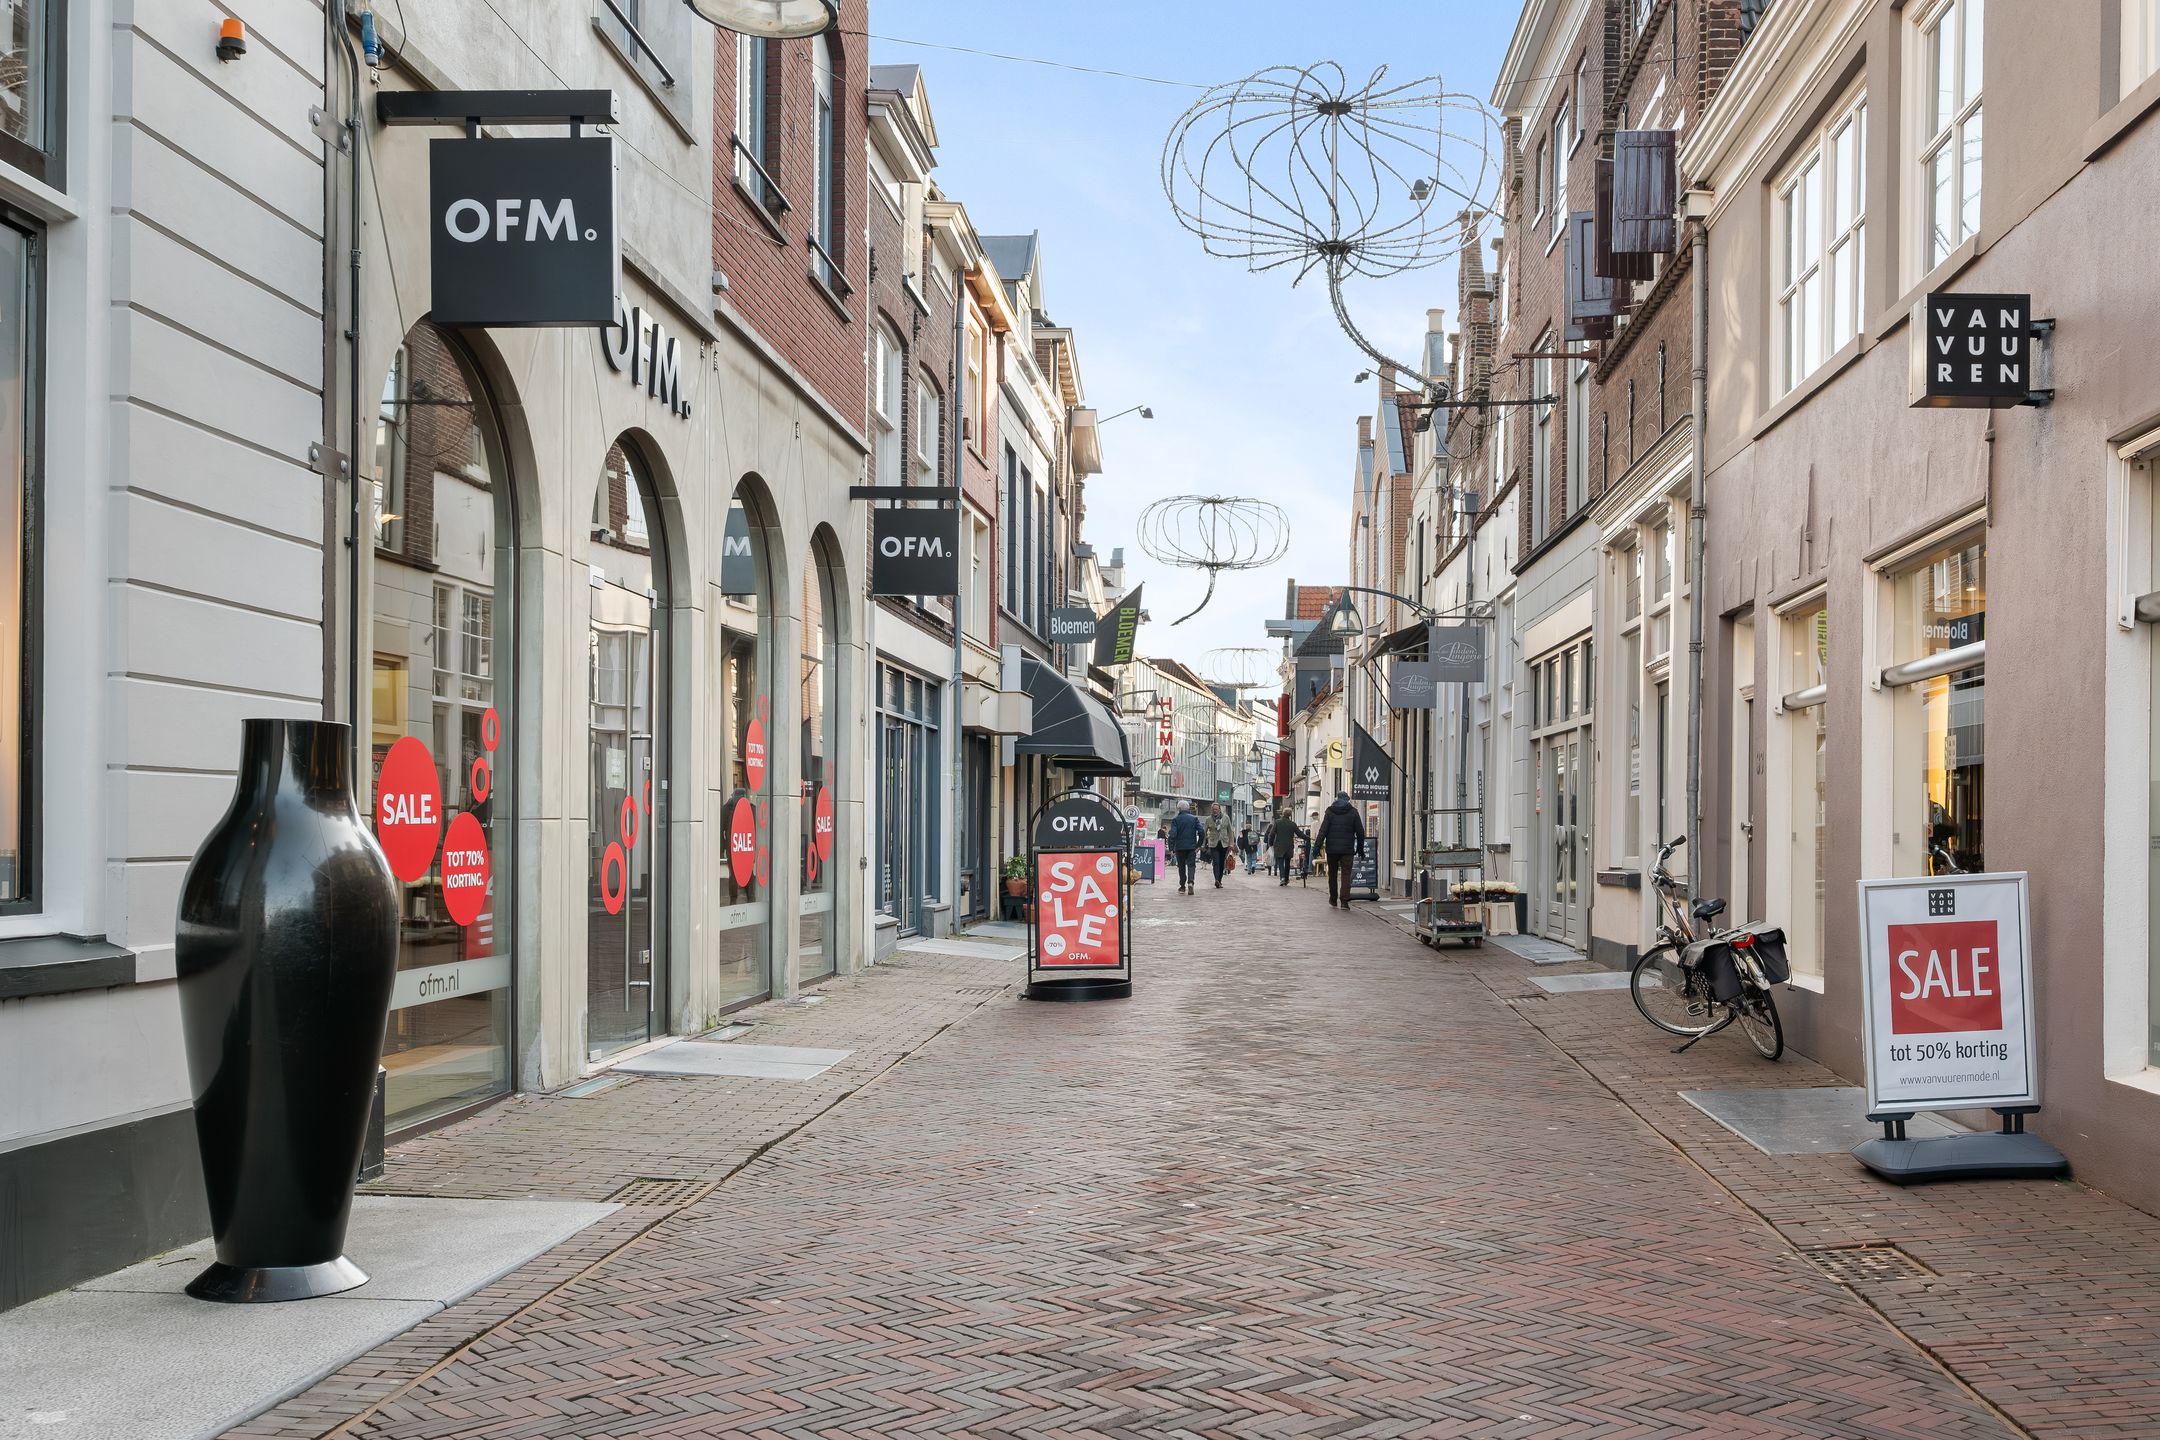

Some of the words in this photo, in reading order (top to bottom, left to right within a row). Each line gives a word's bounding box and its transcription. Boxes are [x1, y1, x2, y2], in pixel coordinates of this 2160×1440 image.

[1935, 308, 2019, 328] VAN
[1935, 336, 2018, 356] VUU
[1937, 363, 2019, 383] REN
[1051, 617, 1095, 635] Bloemen
[1114, 607, 1137, 663] BLOEMEN
[1160, 697, 1173, 764] HEMA
[382, 793, 437, 826] SALE.
[732, 832, 754, 853] SALE.
[446, 851, 465, 868] TOT
[466, 849, 485, 866] 70%
[446, 872, 484, 889] KORTING.
[419, 968, 460, 997] ofm.nl
[1897, 947, 1993, 1000] SALE
[1890, 1044, 1912, 1062] tot
[1916, 1042, 1951, 1061] 50%
[1956, 1040, 2008, 1061] korting
[1899, 1070, 2000, 1085] www.vanvuurenmode.nl
